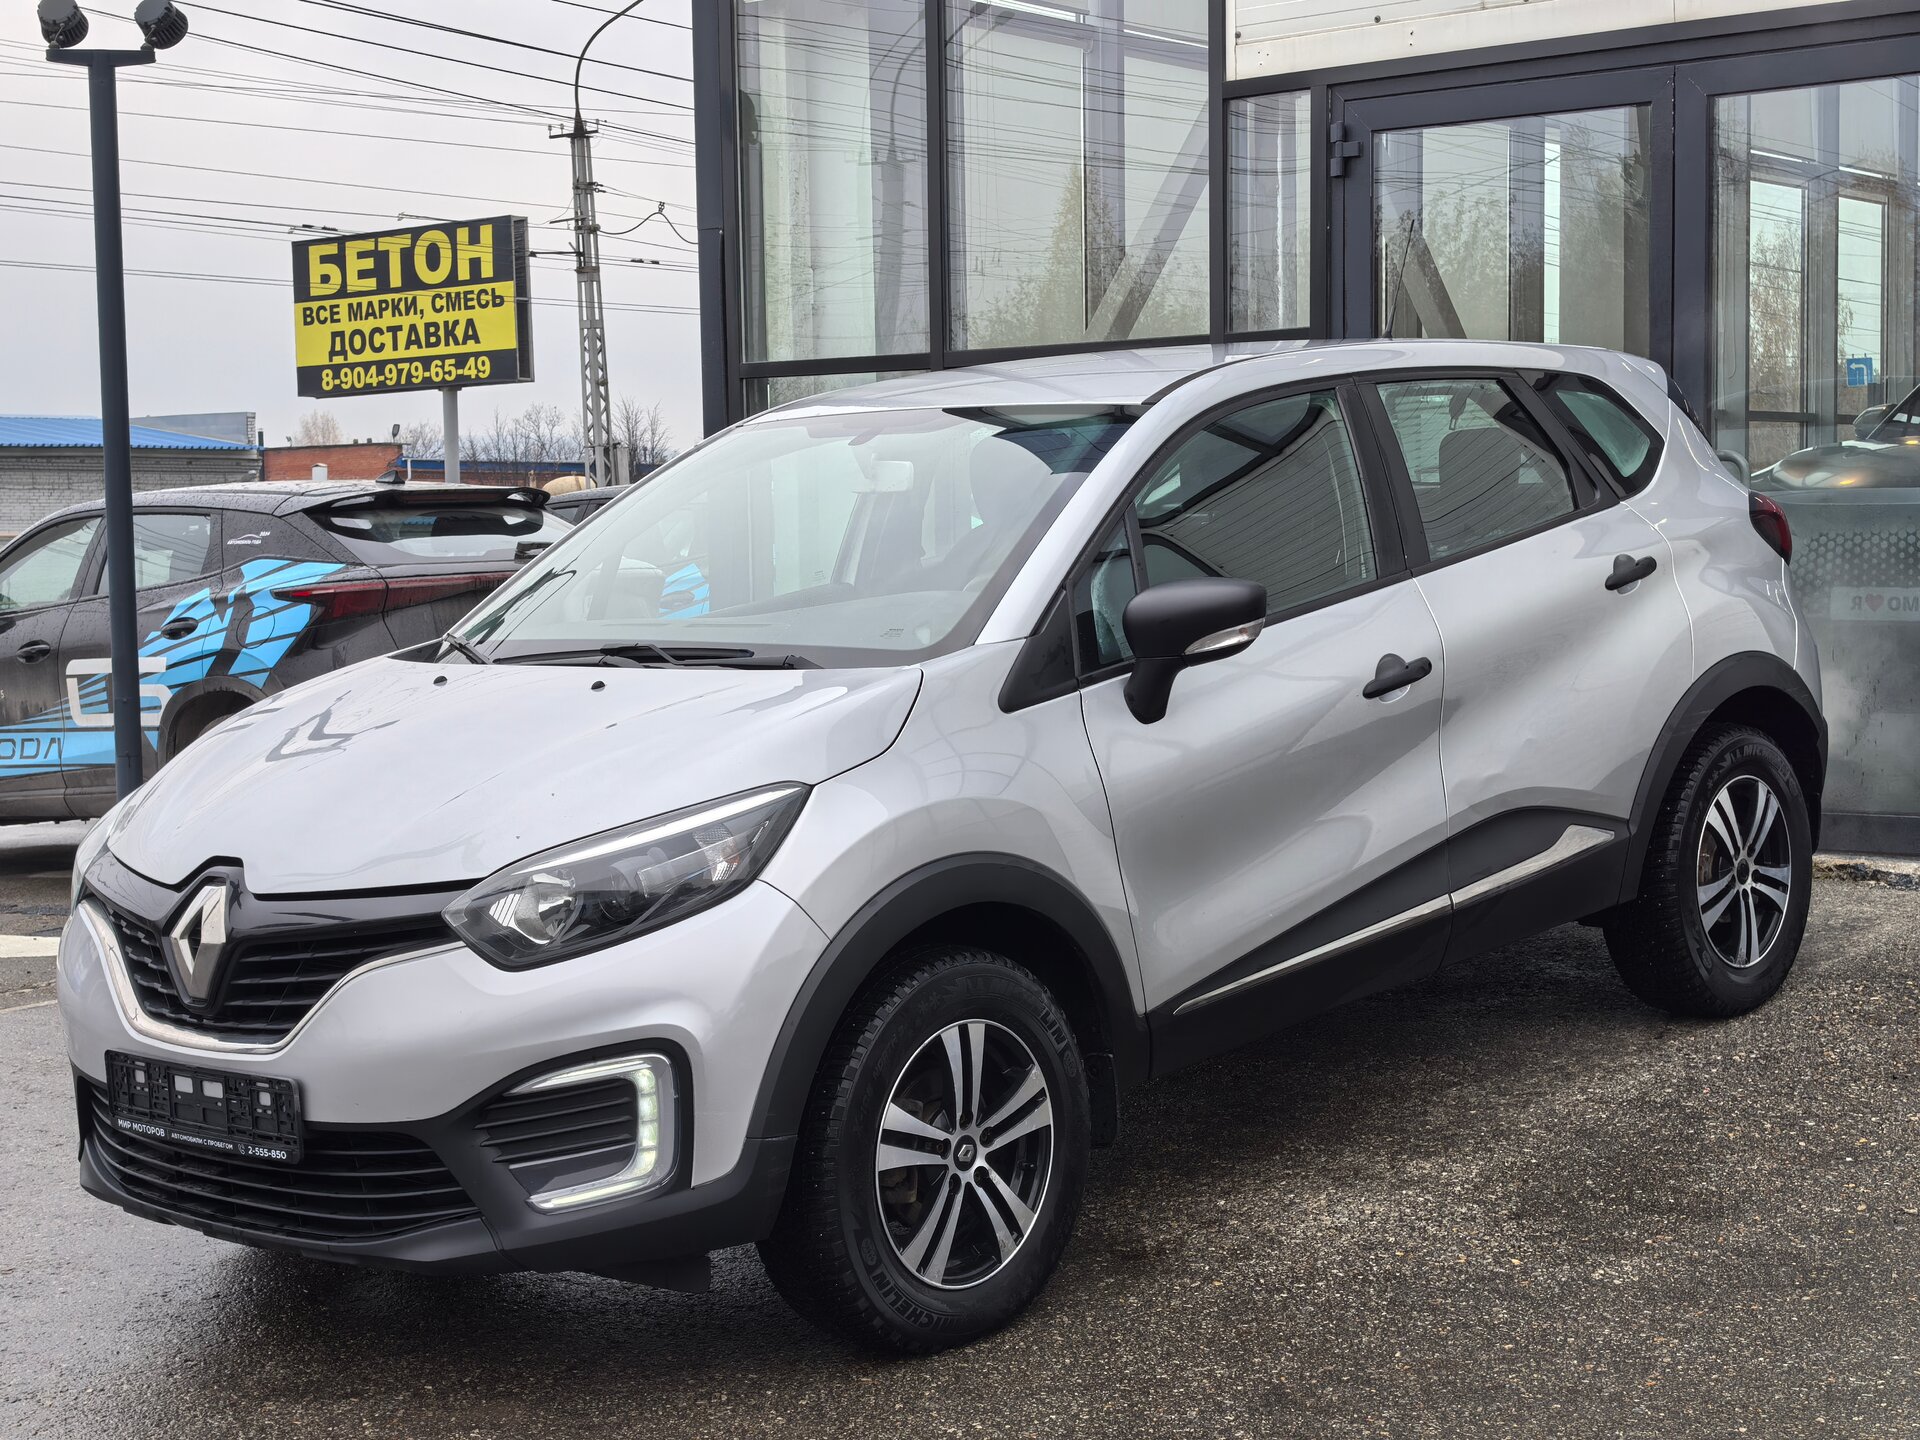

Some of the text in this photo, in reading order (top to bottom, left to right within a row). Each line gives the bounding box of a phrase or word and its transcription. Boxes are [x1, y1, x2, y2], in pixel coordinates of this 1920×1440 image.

[308, 223, 494, 297] БЕТОН
[302, 287, 505, 326] ВСЕ МАРКИ, СМЕСЬ
[328, 317, 481, 363] ДОСТАВКА
[321, 355, 491, 391] 8-904-979-65-49
[117, 1118, 131, 1129] МИР
[132, 1122, 166, 1137] МОТОРОВ
[171, 1132, 203, 1145] АВТОМОБИЛИ
[208, 1138, 233, 1150] ПРОБЕГОМ
[248, 1145, 287, 1160] 2-555-850
